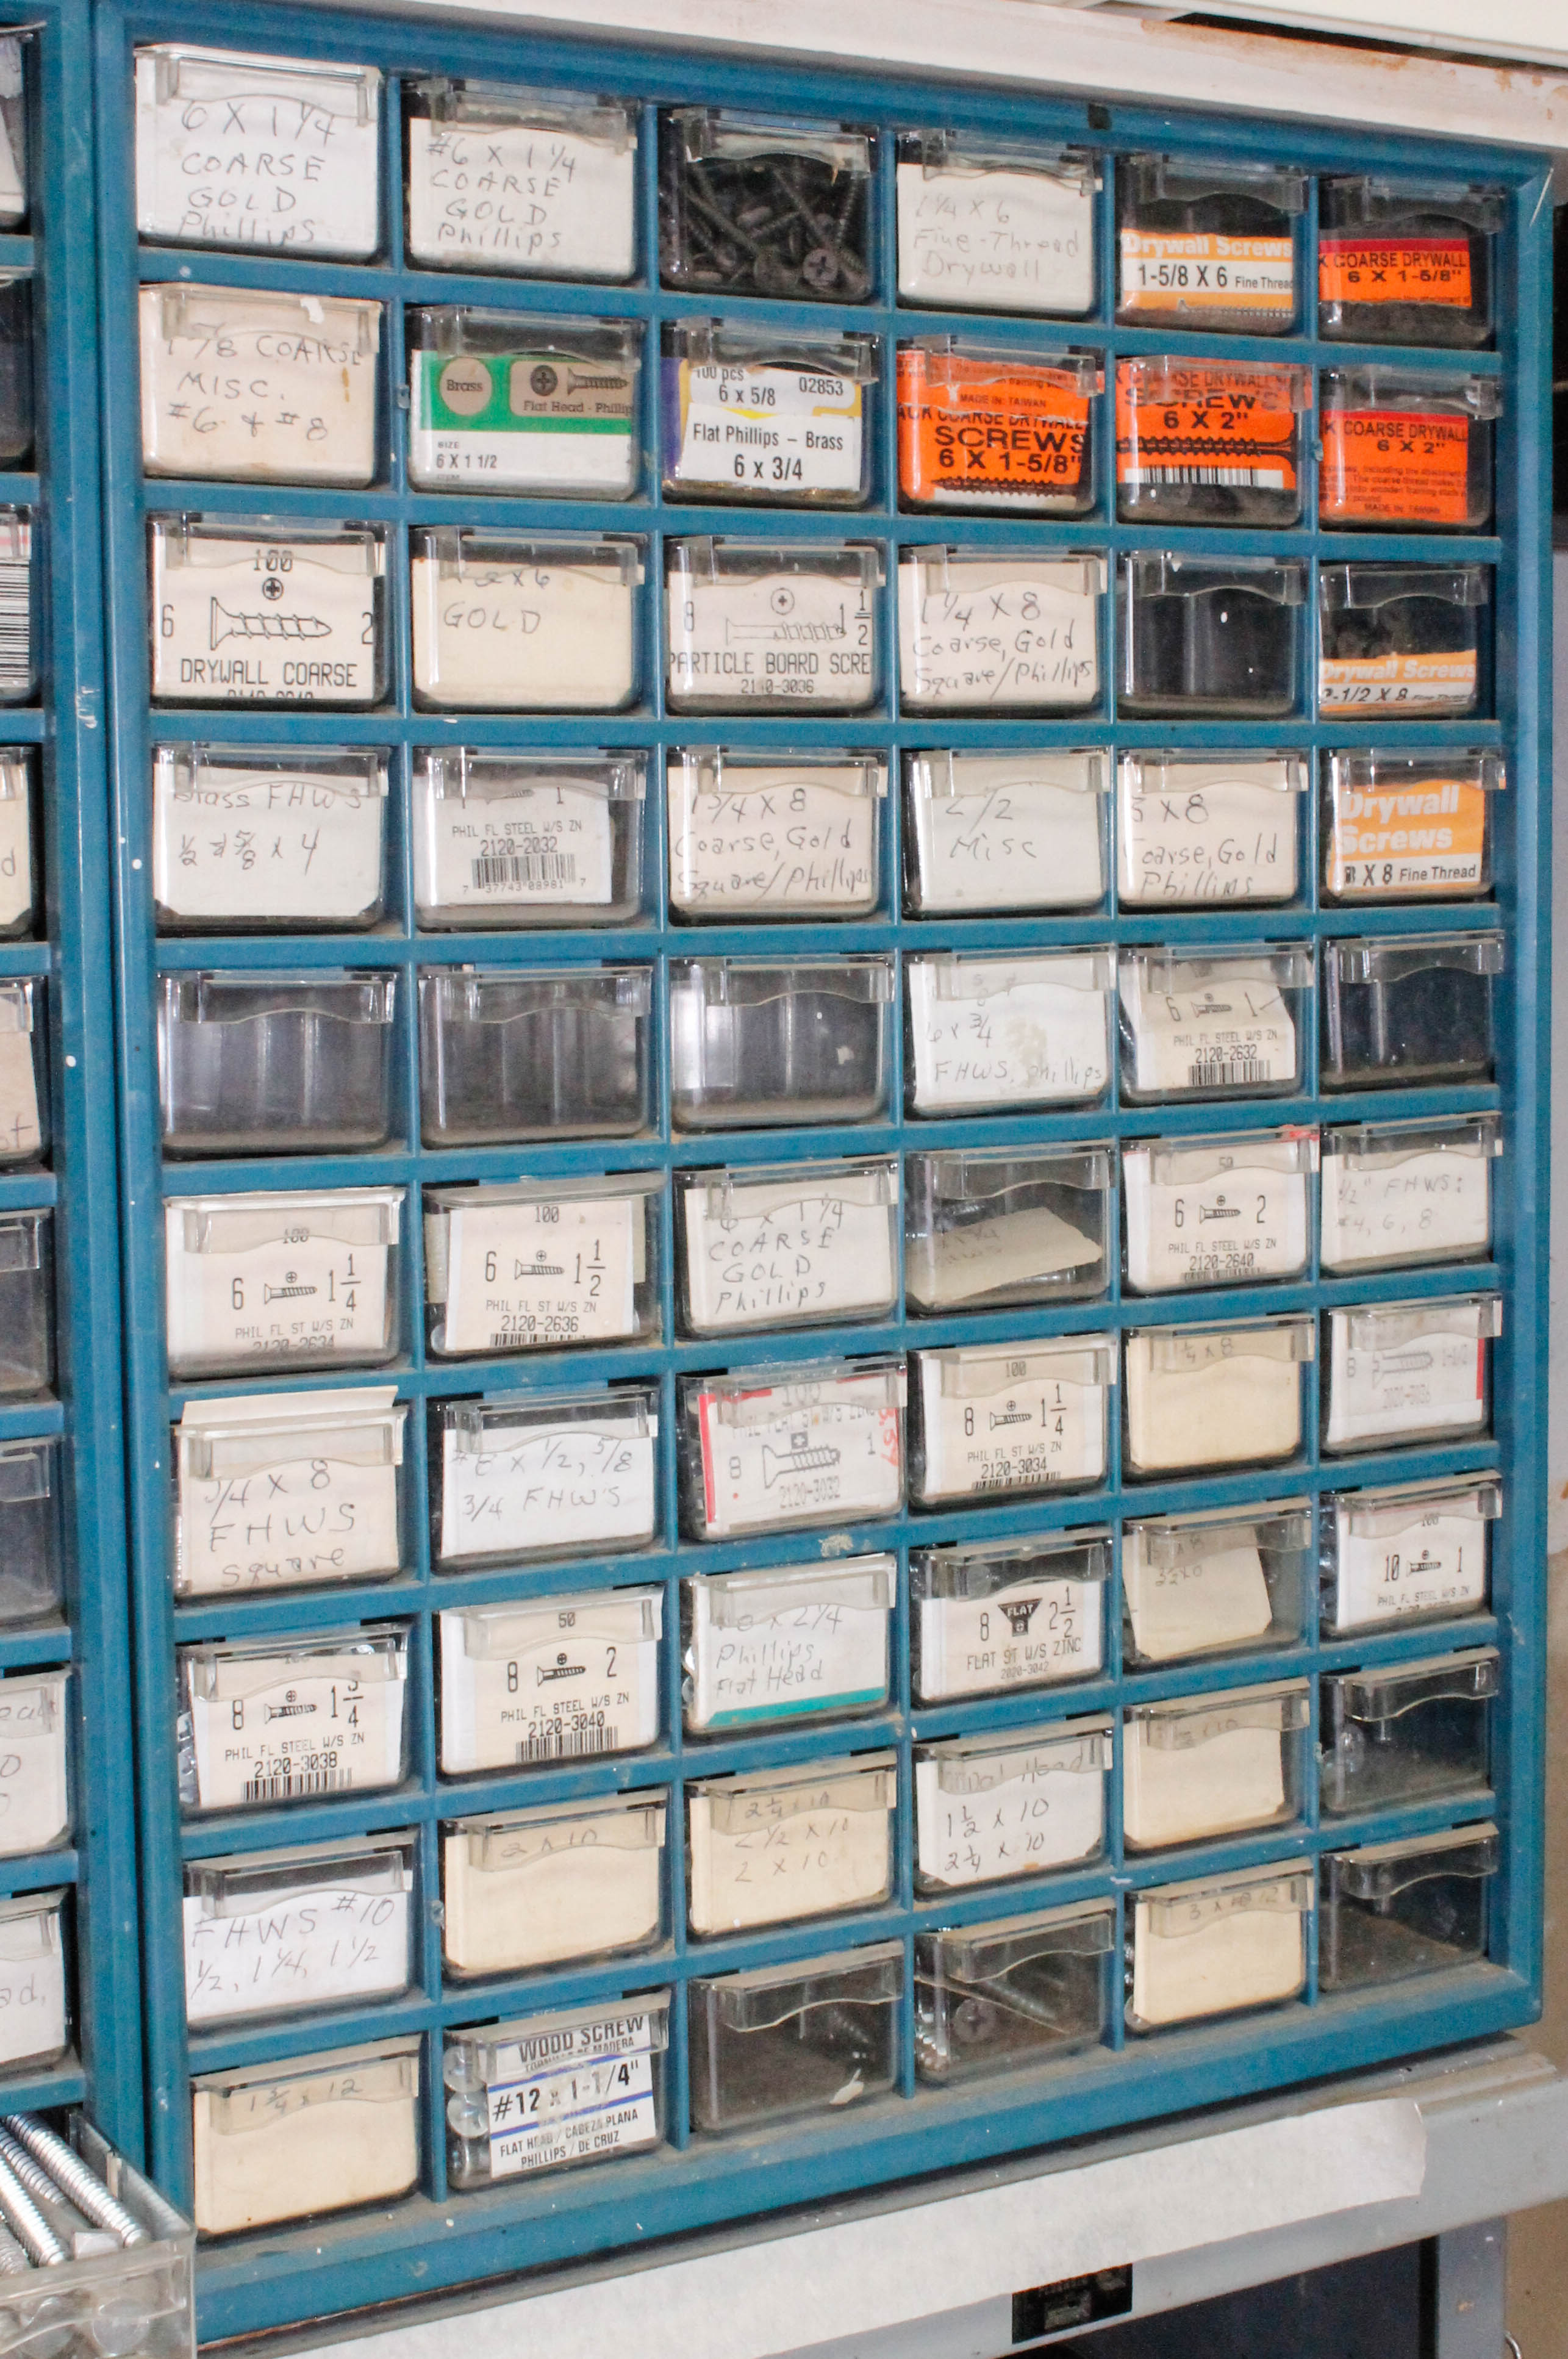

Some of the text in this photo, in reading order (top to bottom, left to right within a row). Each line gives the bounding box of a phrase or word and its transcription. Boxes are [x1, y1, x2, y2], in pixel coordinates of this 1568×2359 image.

[223, 102, 245, 134] X
[181, 152, 326, 181] COARSE
[432, 170, 560, 197] COARSE
[188, 187, 296, 213] GOLD
[446, 198, 547, 226] GOLD
[1123, 234, 1293, 258] Drywall Screws
[922, 251, 1040, 285] Drywall
[1334, 253, 1397, 268] COARSE
[1403, 253, 1466, 268] DRYWALL
[1139, 264, 1258, 289] 1-5/8 X 6 Fine
[1348, 270, 1386, 283] 6 X
[446, 379, 483, 393] Brass
[719, 384, 776, 406] 6 5/8
[721, 367, 843, 397] pcs 02853
[523, 400, 584, 414] Flat Head
[960, 393, 1046, 408] MADE TAIWAN
[1164, 411, 1209, 429] 6 X
[1344, 421, 1405, 439] COARSE
[693, 423, 843, 450] Flat Phillips Brass
[935, 425, 1085, 454] SCREWS
[1377, 440, 1414, 453] 6 X
[436, 454, 498, 470] 6 X 1/2
[734, 454, 803, 481] 6 x 3/4
[939, 448, 954, 468] 6
[967, 450, 986, 470] X
[254, 549, 294, 572] 100
[444, 601, 541, 634] GOLD
[684, 601, 694, 632] 8
[1021, 592, 1041, 620] 8
[161, 604, 374, 645] 6 2
[1015, 619, 1075, 653] Gold
[181, 659, 358, 688] DRYWALL COARSE
[670, 652, 754, 675] PARTICLE
[765, 653, 819, 675] BOARD
[1322, 659, 1475, 683] Drywall Screws
[1376, 688, 1392, 702] X
[790, 788, 806, 811] 8
[1186, 794, 1209, 824] 8
[1341, 785, 1460, 825] Drywall
[453, 820, 582, 838] PHIL FL STEEL ZN
[787, 818, 851, 851] Gold
[1339, 825, 1454, 855] Screws
[301, 827, 320, 875] 4
[481, 836, 557, 857] 2120-2032
[1218, 832, 1277, 865] Gold
[1362, 864, 1375, 886] X
[1382, 863, 1393, 884] 8
[1400, 867, 1428, 883] Fine
[1431, 864, 1476, 880] Thread
[1165, 996, 1181, 1022] 6
[1215, 1032, 1240, 1044] STEEL
[535, 1206, 559, 1223] 100
[1175, 1194, 1267, 1228] 6 2
[708, 1227, 835, 1262] COARSE
[1169, 1238, 1276, 1254] PHIL FL STEEL ZN
[484, 1251, 497, 1282] 6
[722, 1255, 811, 1283] GOLD
[1189, 1252, 1255, 1272] 2120-2640
[232, 1277, 244, 1310] 6
[485, 1299, 596, 1313] PHIL FL ST W/S ZN
[235, 1318, 354, 1338] PHIL FL ST W/S ZN
[501, 1315, 579, 1332] 2120-2636
[964, 1407, 974, 1436] 8
[967, 1442, 1062, 1463] PHIL FL ST W/S ZN
[311, 1459, 331, 1489] 8
[730, 1456, 741, 1479] 8
[981, 1456, 1047, 1479] 2120-3034
[210, 1504, 355, 1552] FHWS
[1384, 1554, 1400, 1582] 10
[980, 1601, 1059, 1642] 8 2
[1007, 1604, 1034, 1617] FLAT
[967, 1637, 1082, 1671] FLAT ST W/S ZINC
[507, 1646, 617, 1693] 8 2
[232, 1700, 244, 1730] 8
[501, 1692, 629, 1723] PHIL FL STEEL W/S ZN
[528, 1710, 605, 1740] 2120-3040
[224, 1732, 365, 1762] PHIL FL STEEL W/S ZN
[254, 1751, 337, 1779] 2120-3038
[1020, 1798, 1049, 1823] 10
[734, 1861, 752, 1883] 2
[945, 1851, 959, 1872] 2
[192, 1908, 317, 1948] FHWS
[518, 2033, 574, 2064] WOOD
[580, 2015, 644, 2044] SCREW
[492, 2087, 541, 2123] #12
[499, 2139, 524, 2158] FLAT
[605, 2108, 639, 2127] PLANA
[521, 2130, 620, 2169] PHILLIPS DE CRUZ
